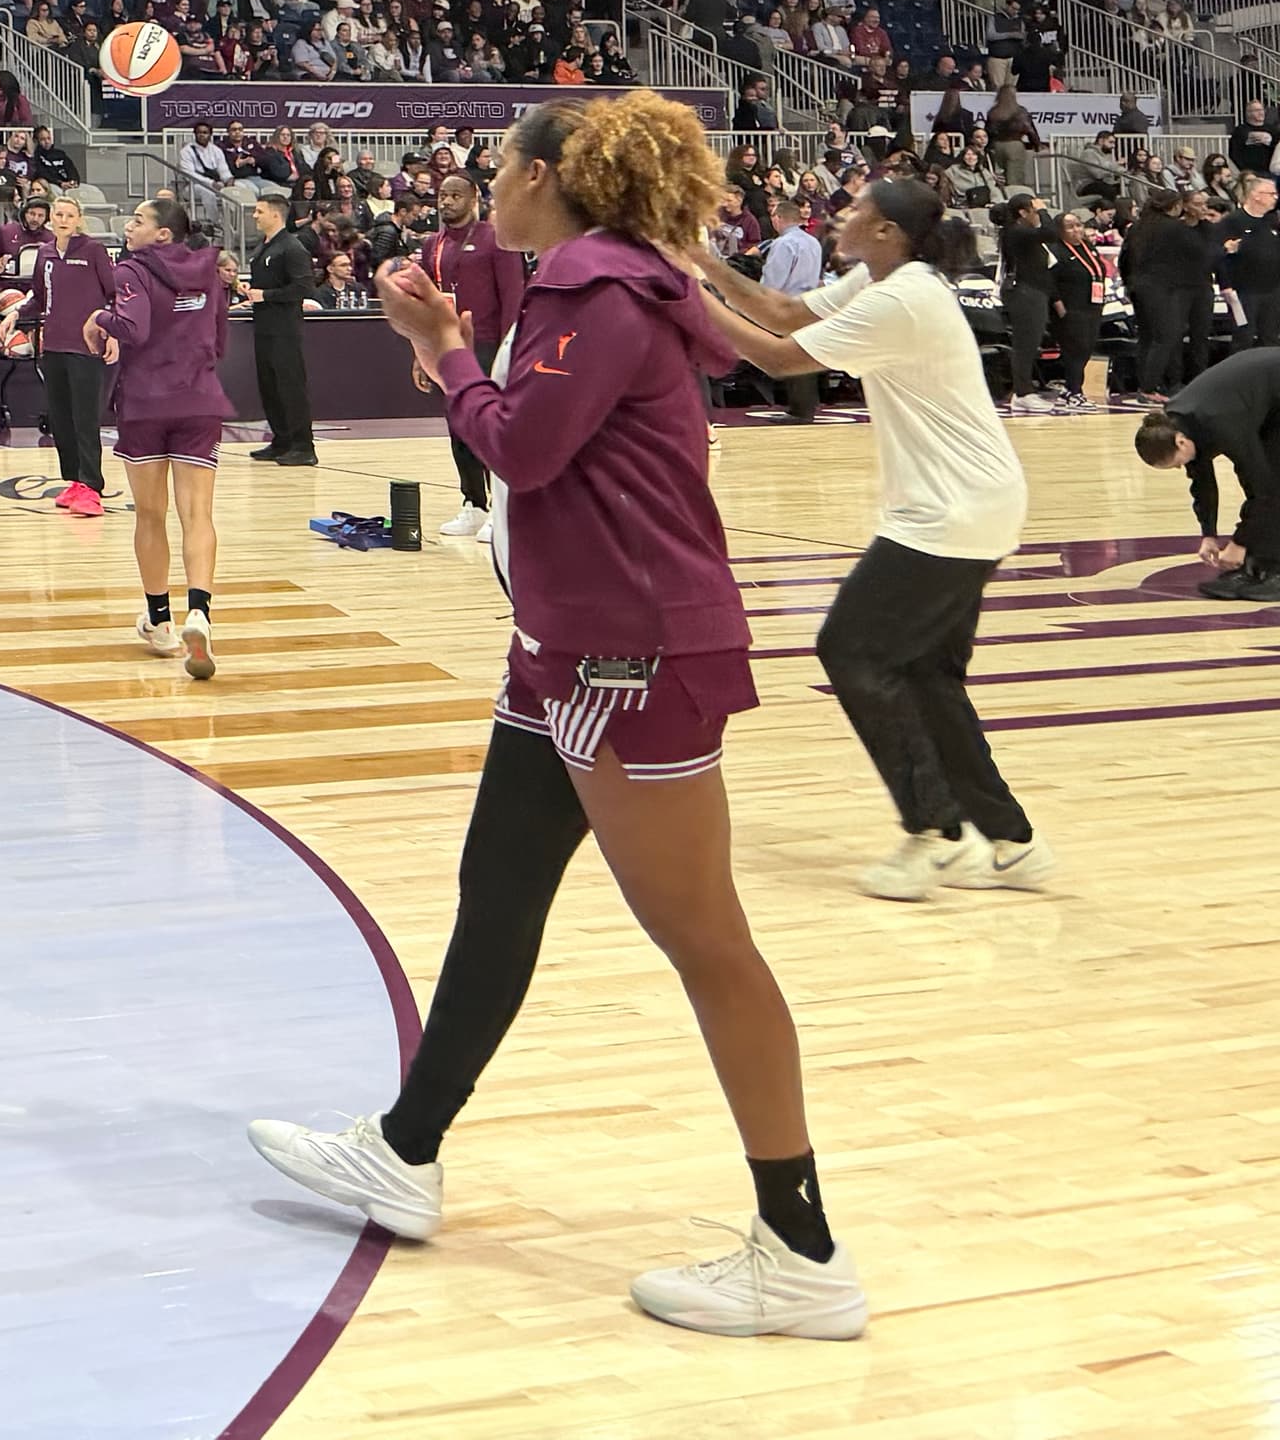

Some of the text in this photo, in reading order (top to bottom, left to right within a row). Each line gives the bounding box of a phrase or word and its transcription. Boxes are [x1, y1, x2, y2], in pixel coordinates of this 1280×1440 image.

[161, 101, 504, 119] TORONTO TEMPO TORONTO
[1030, 112, 1118, 124] FIRST WNB
